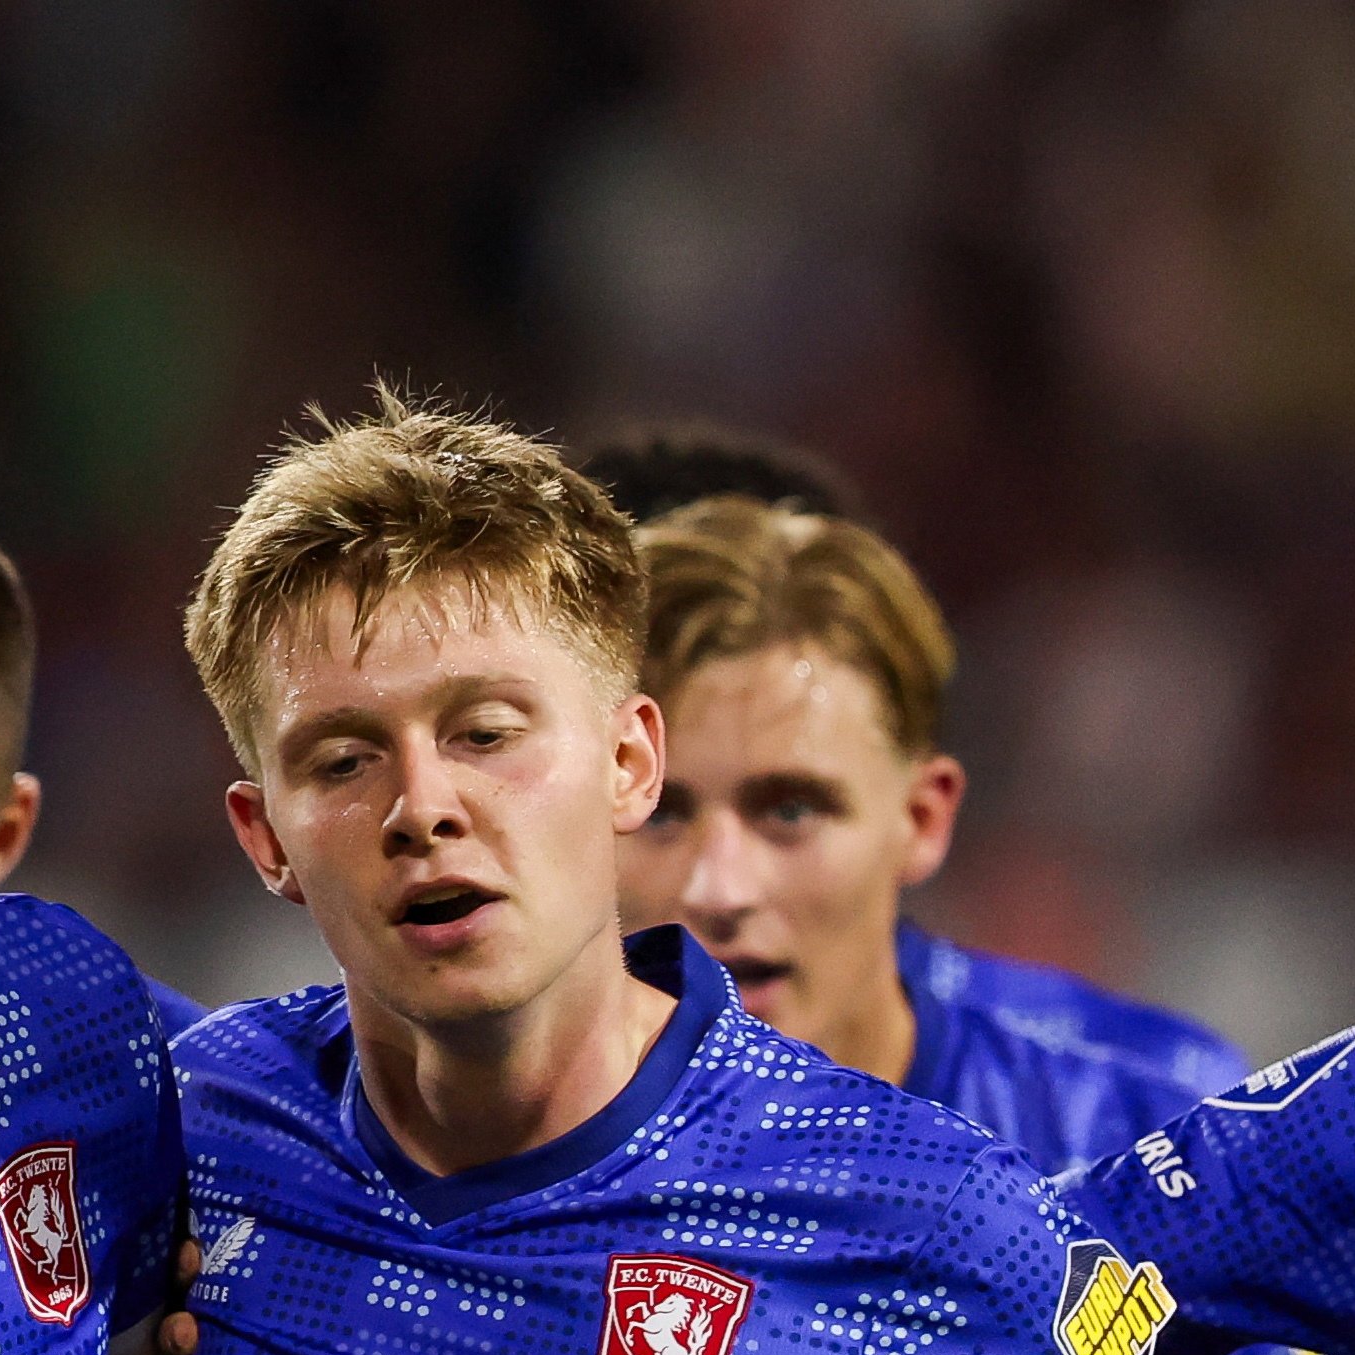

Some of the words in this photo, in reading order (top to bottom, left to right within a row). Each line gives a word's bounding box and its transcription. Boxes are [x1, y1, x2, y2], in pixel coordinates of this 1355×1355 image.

[16, 1157, 66, 1182] TWENTE
[47, 1284, 73, 1306] 1965
[619, 1267, 652, 1283] F.C.
[655, 1268, 737, 1305] TWENTE
